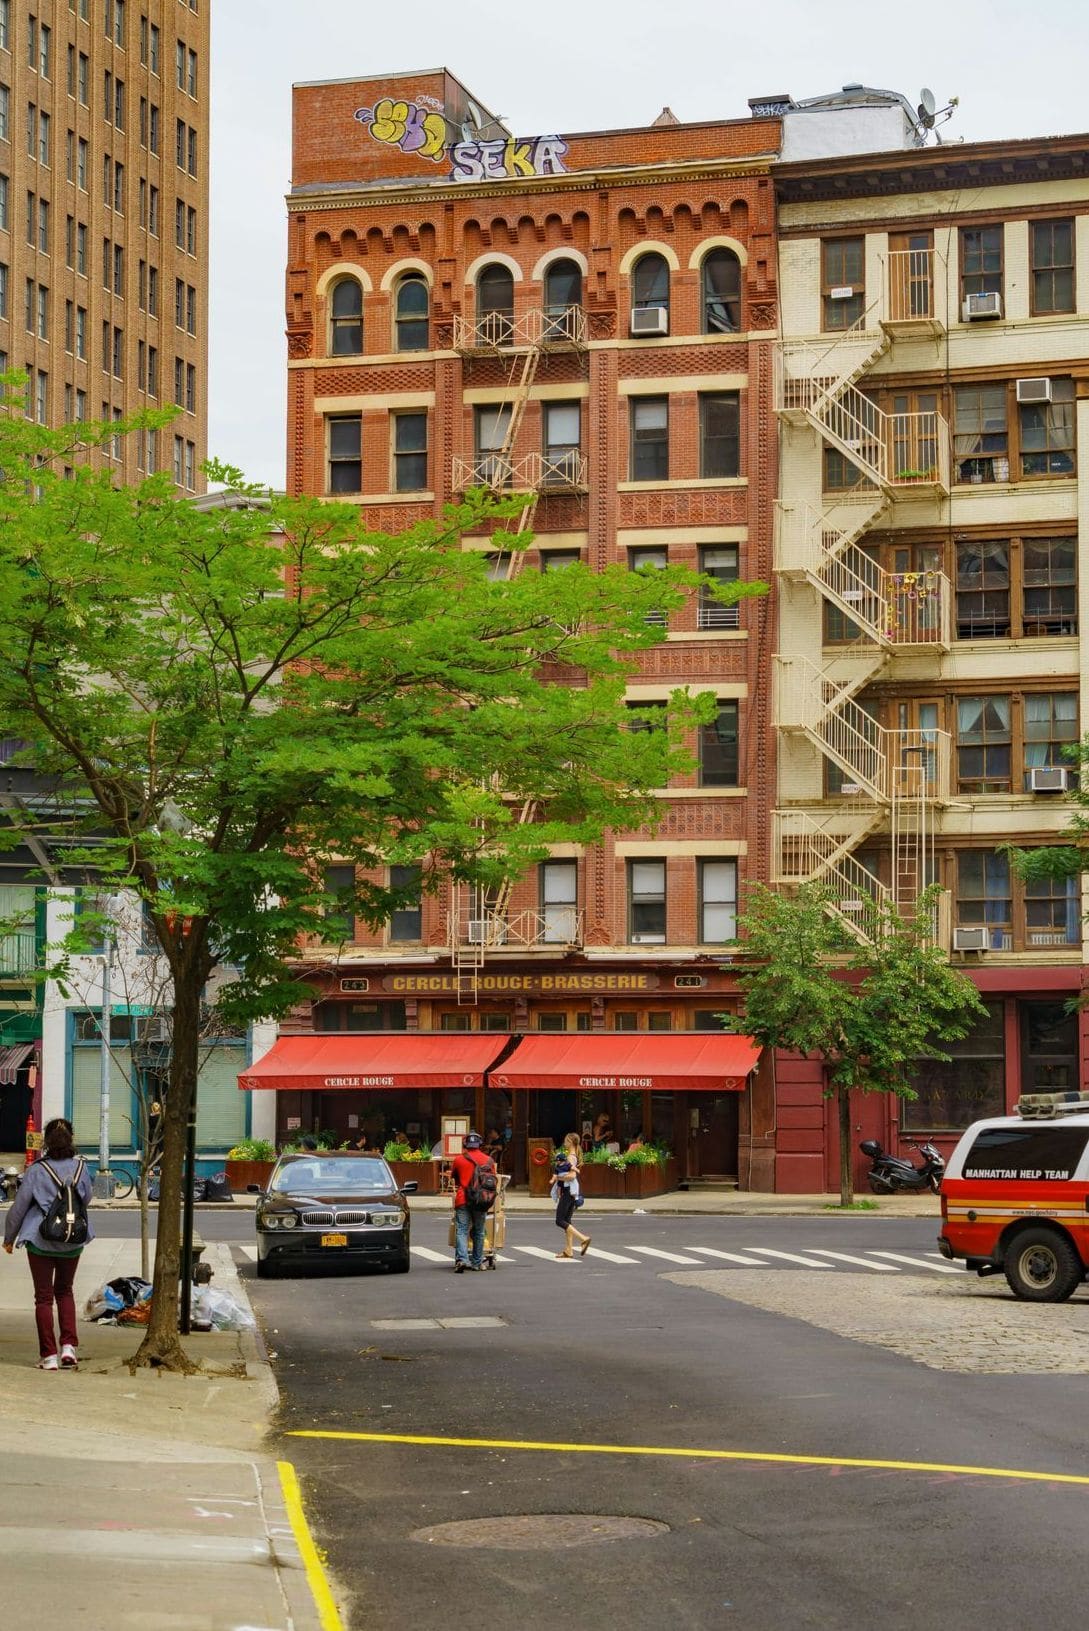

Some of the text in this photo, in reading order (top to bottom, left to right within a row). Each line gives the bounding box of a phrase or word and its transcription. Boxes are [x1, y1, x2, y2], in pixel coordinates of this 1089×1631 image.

[451, 135, 567, 181] SEKA
[393, 975, 647, 990] CERCLE ROUGE BRASSERIE
[324, 1077, 394, 1086] CERCLE ROUGE
[579, 1077, 652, 1087] CERCLE ROUGE
[965, 1169, 1069, 1180] MANHATTAN HELP TEAM
